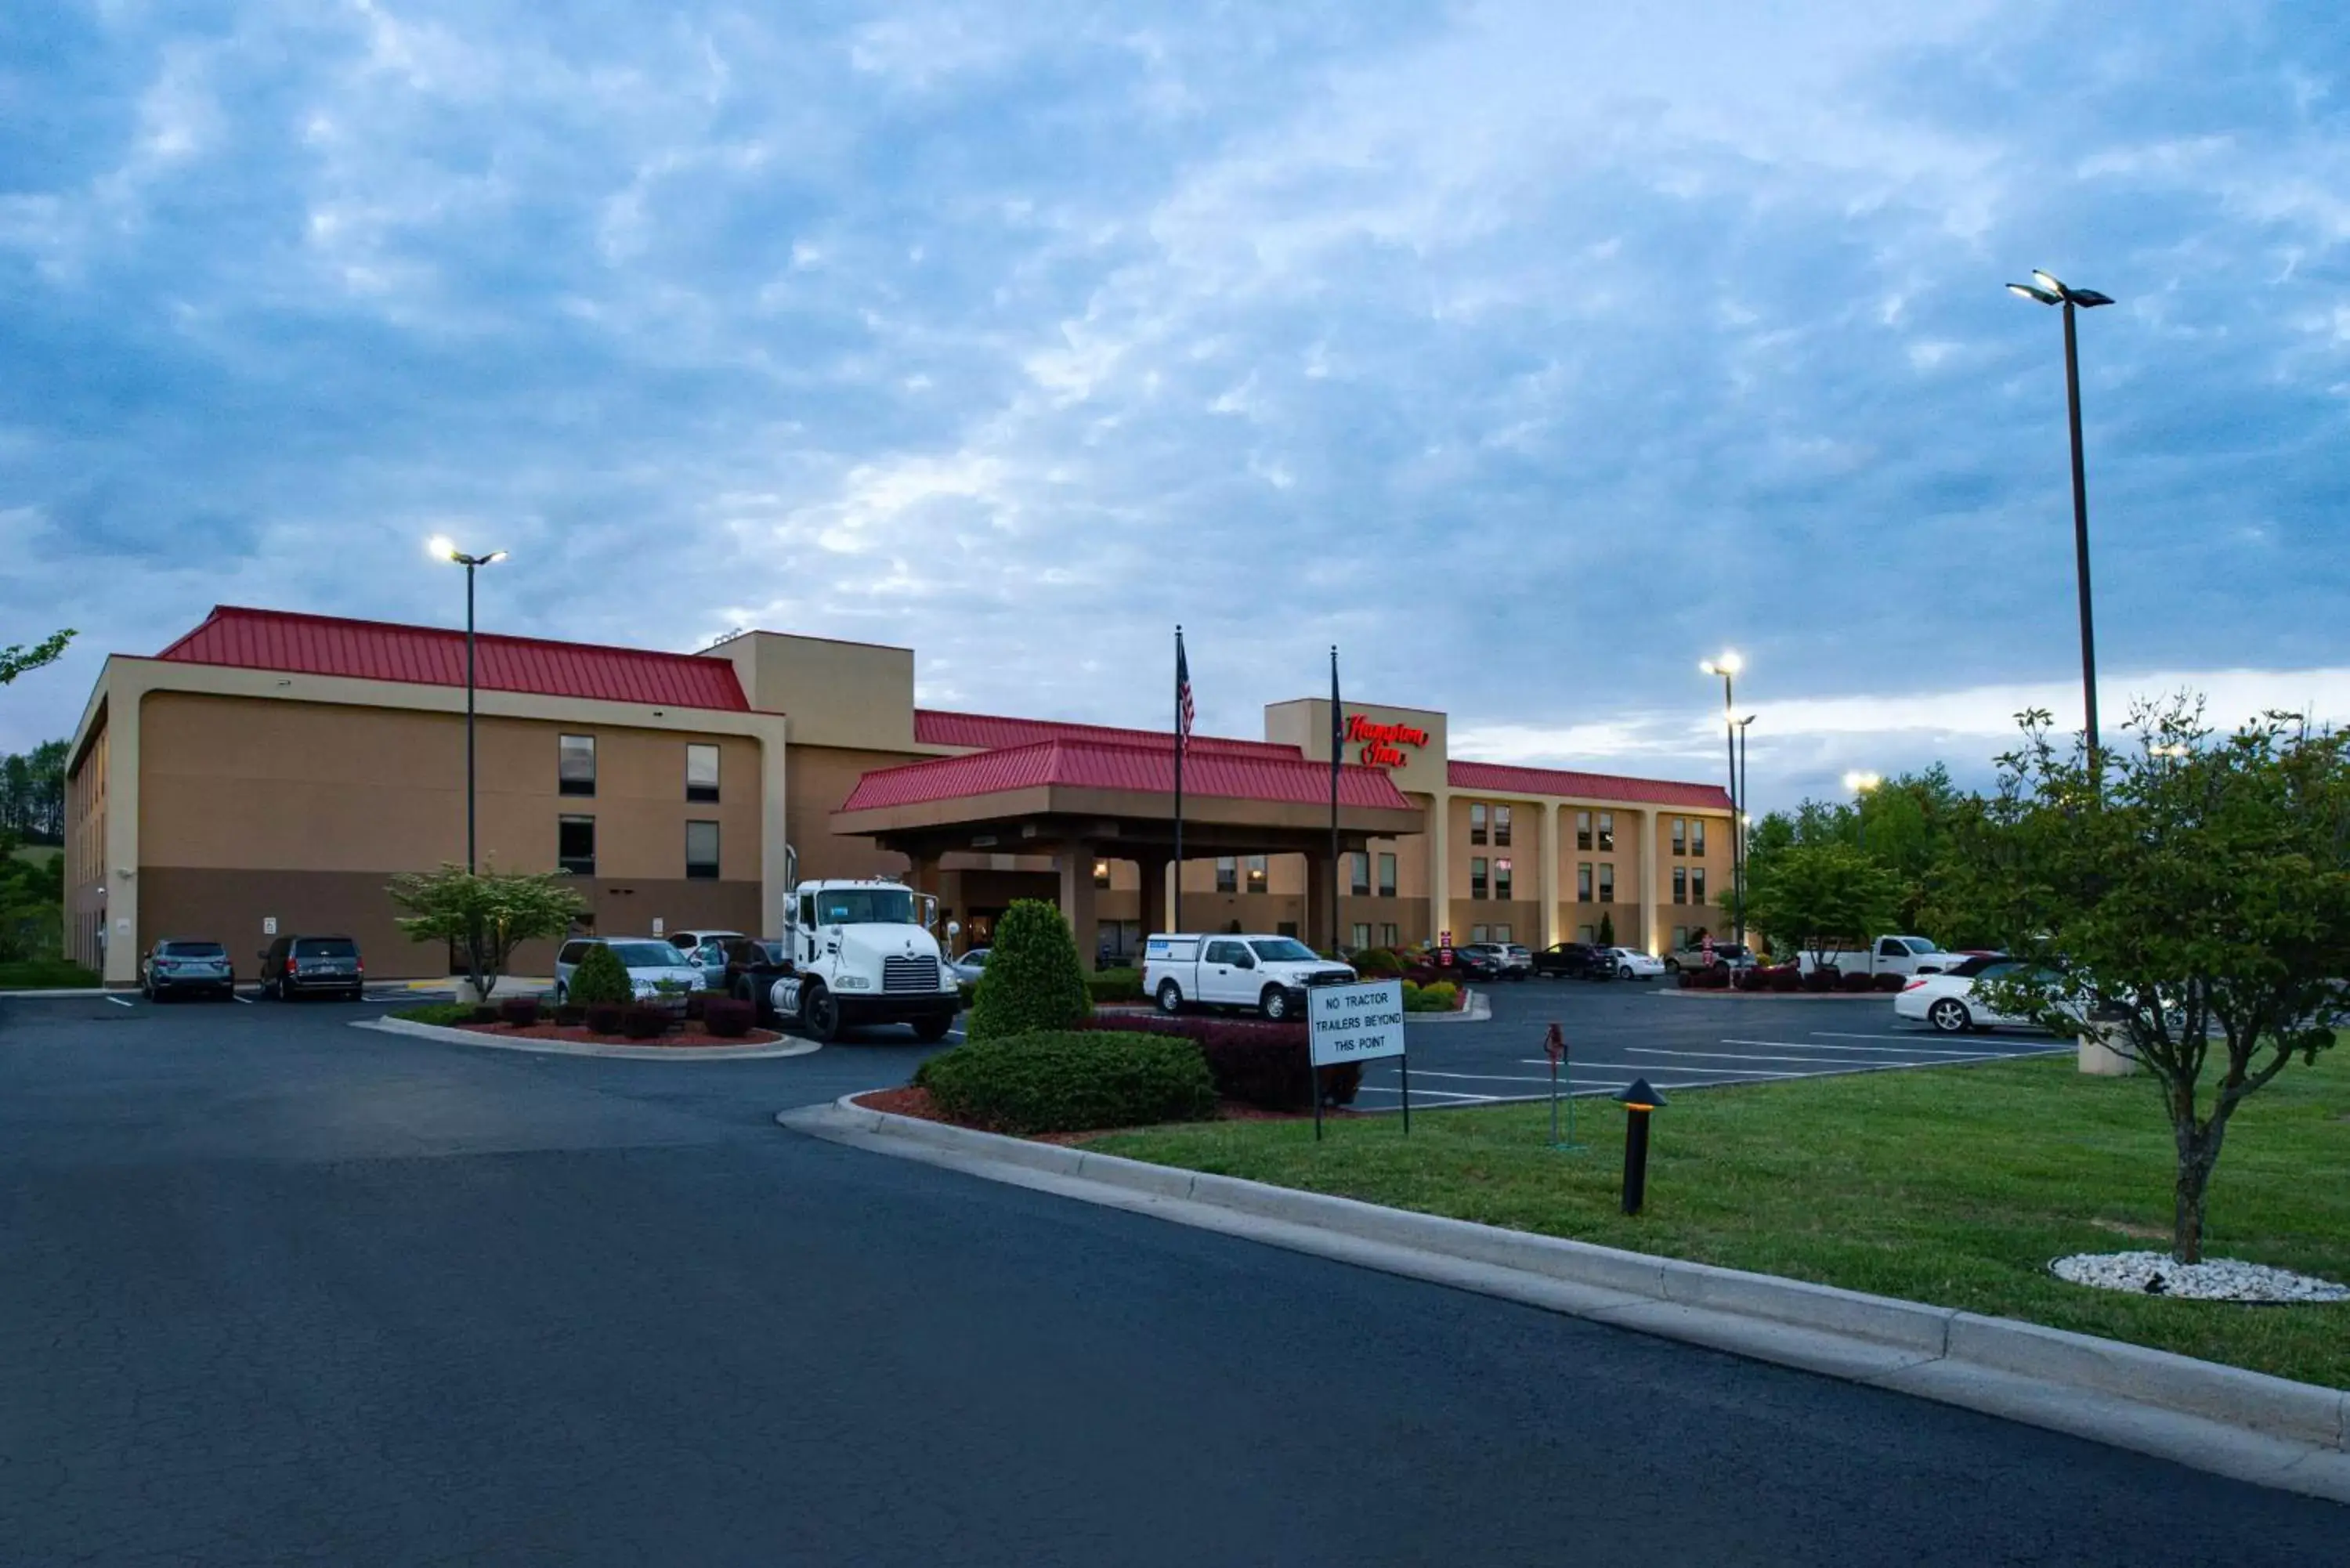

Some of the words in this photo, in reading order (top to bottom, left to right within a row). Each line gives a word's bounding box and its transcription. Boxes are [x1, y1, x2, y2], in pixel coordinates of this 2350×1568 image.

[1345, 714, 1429, 747] Hampton
[1361, 741, 1406, 768] Inn
[1325, 996, 1340, 1010] NO
[1345, 992, 1389, 1009] TRACTOR
[1316, 1017, 1360, 1033] TRAILERS
[1365, 1013, 1401, 1028] BEYOND
[1334, 1039, 1354, 1052] THIS
[1359, 1035, 1385, 1050] POINT
